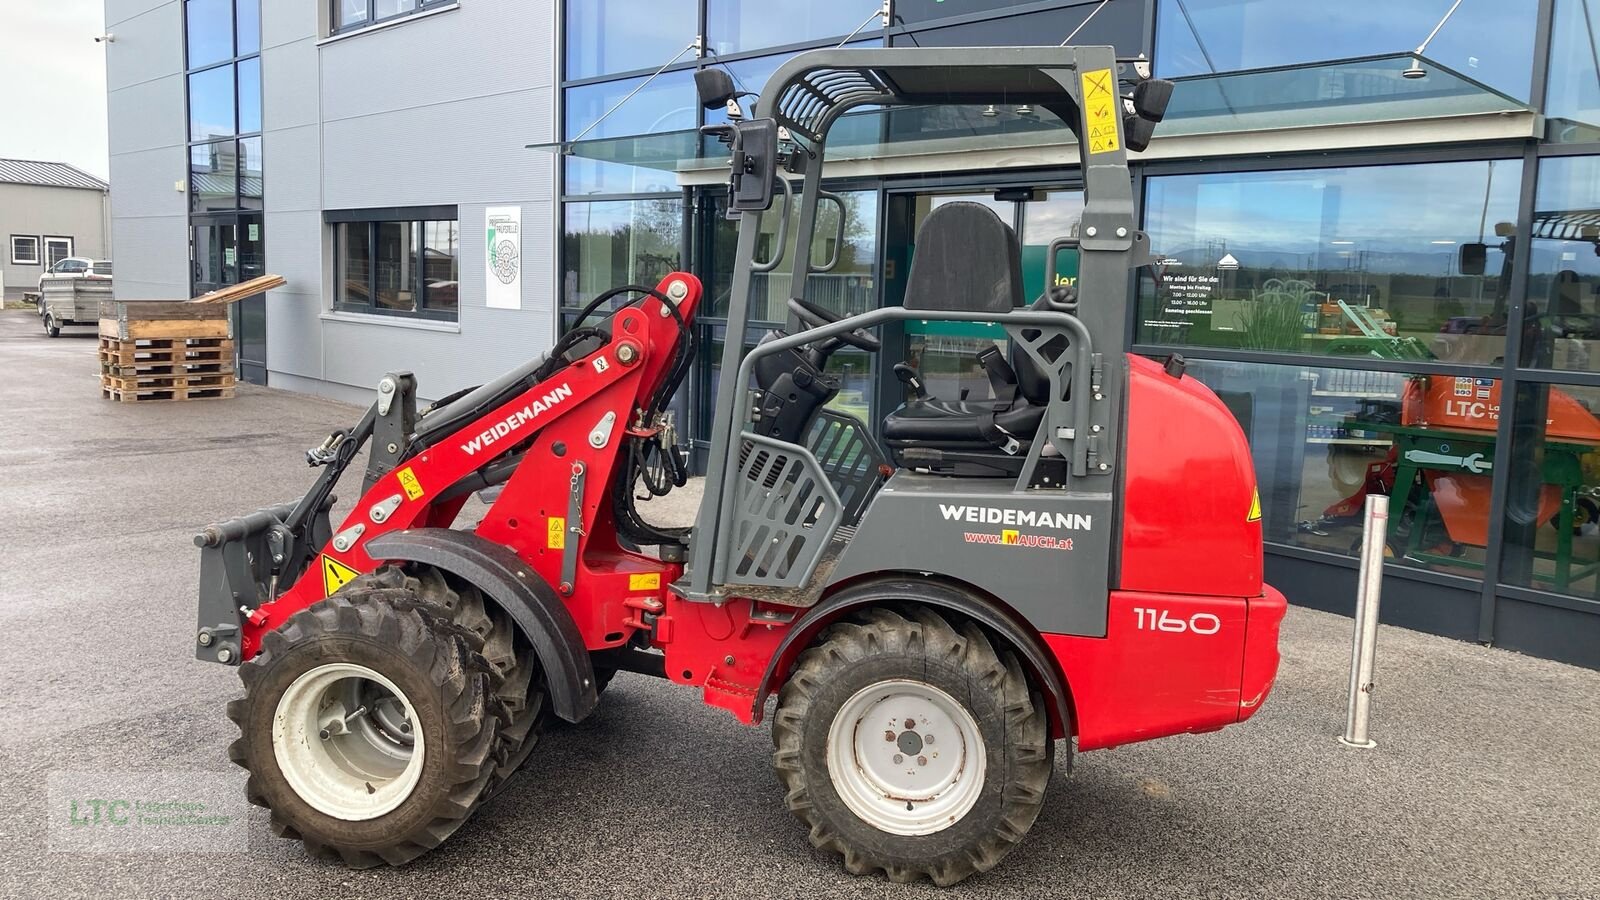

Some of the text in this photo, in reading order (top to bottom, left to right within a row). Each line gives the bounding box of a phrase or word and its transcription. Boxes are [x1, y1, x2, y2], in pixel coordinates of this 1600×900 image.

[460, 382, 573, 456] WEIDEMANN
[1446, 399, 1485, 418] LTC
[938, 504, 1092, 530] WEIDEMANN
[1133, 607, 1221, 635] 1160
